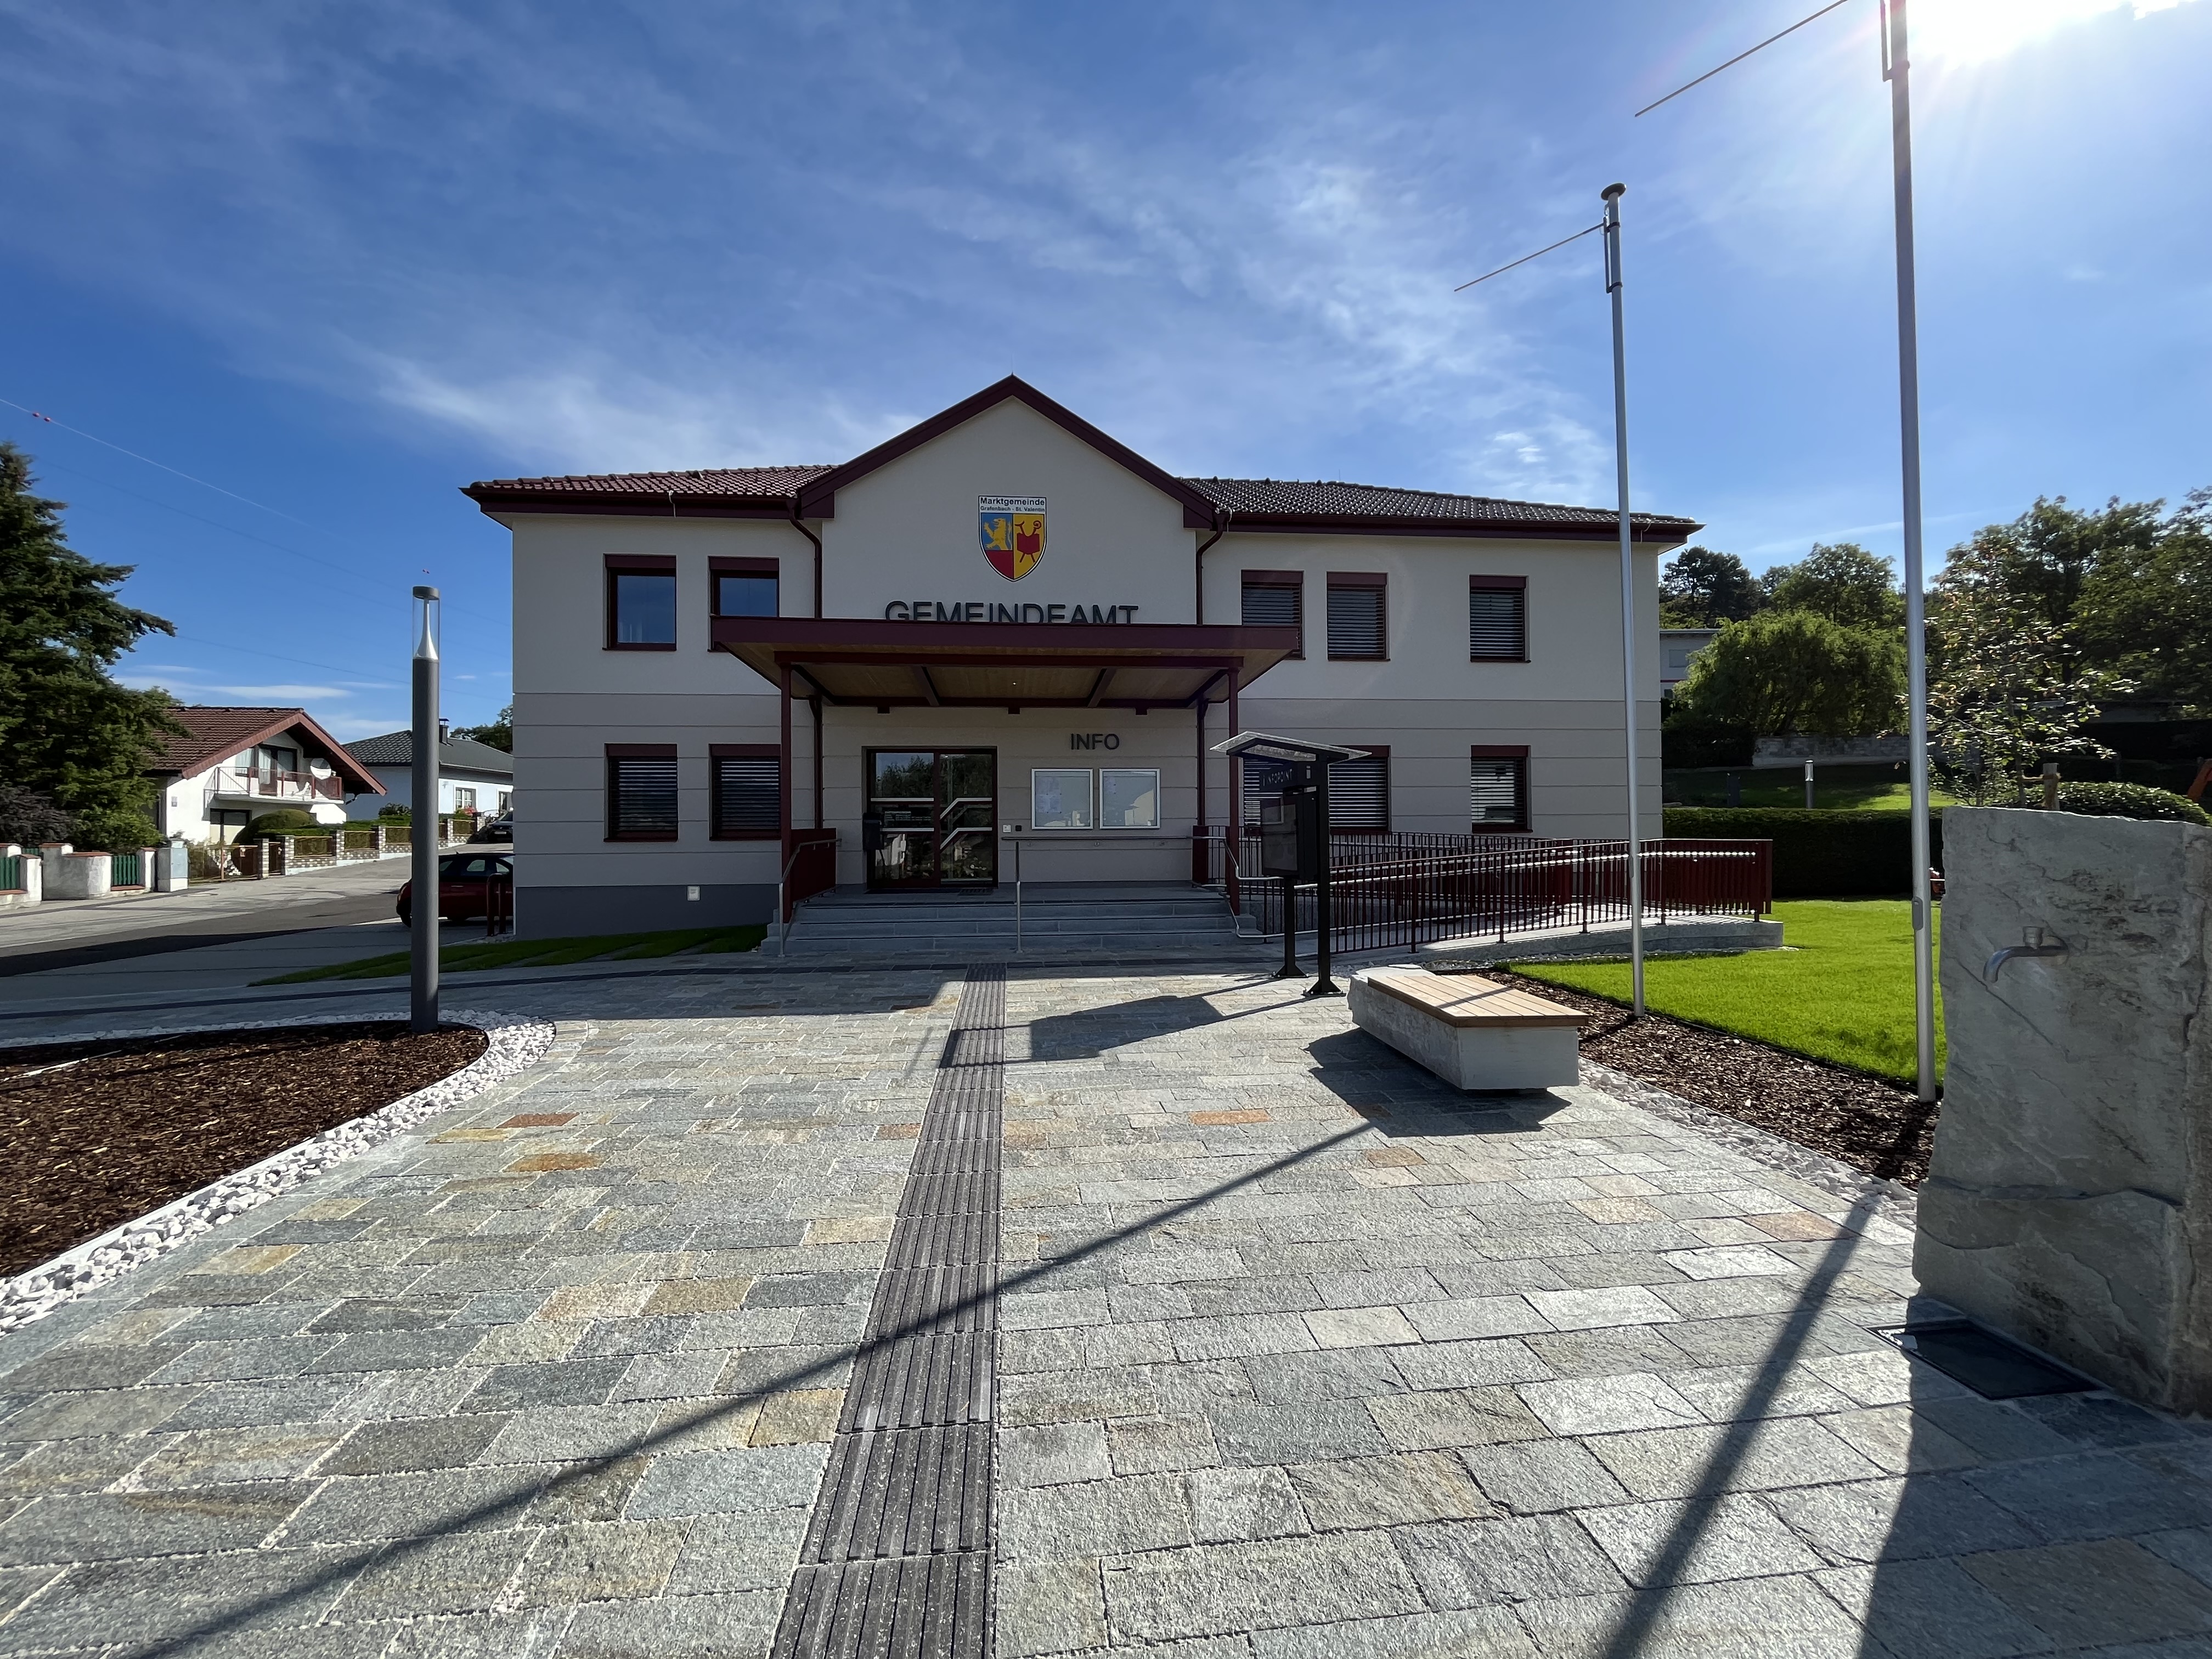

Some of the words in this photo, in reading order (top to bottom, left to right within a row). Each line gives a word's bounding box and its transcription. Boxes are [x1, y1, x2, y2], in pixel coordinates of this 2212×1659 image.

[980, 498, 1045, 506] Marktgemeinde
[885, 601, 1139, 624] GEMEINDEAMT
[1071, 733, 1120, 750] INFO
[1267, 768, 1293, 785] INFOPOINT
